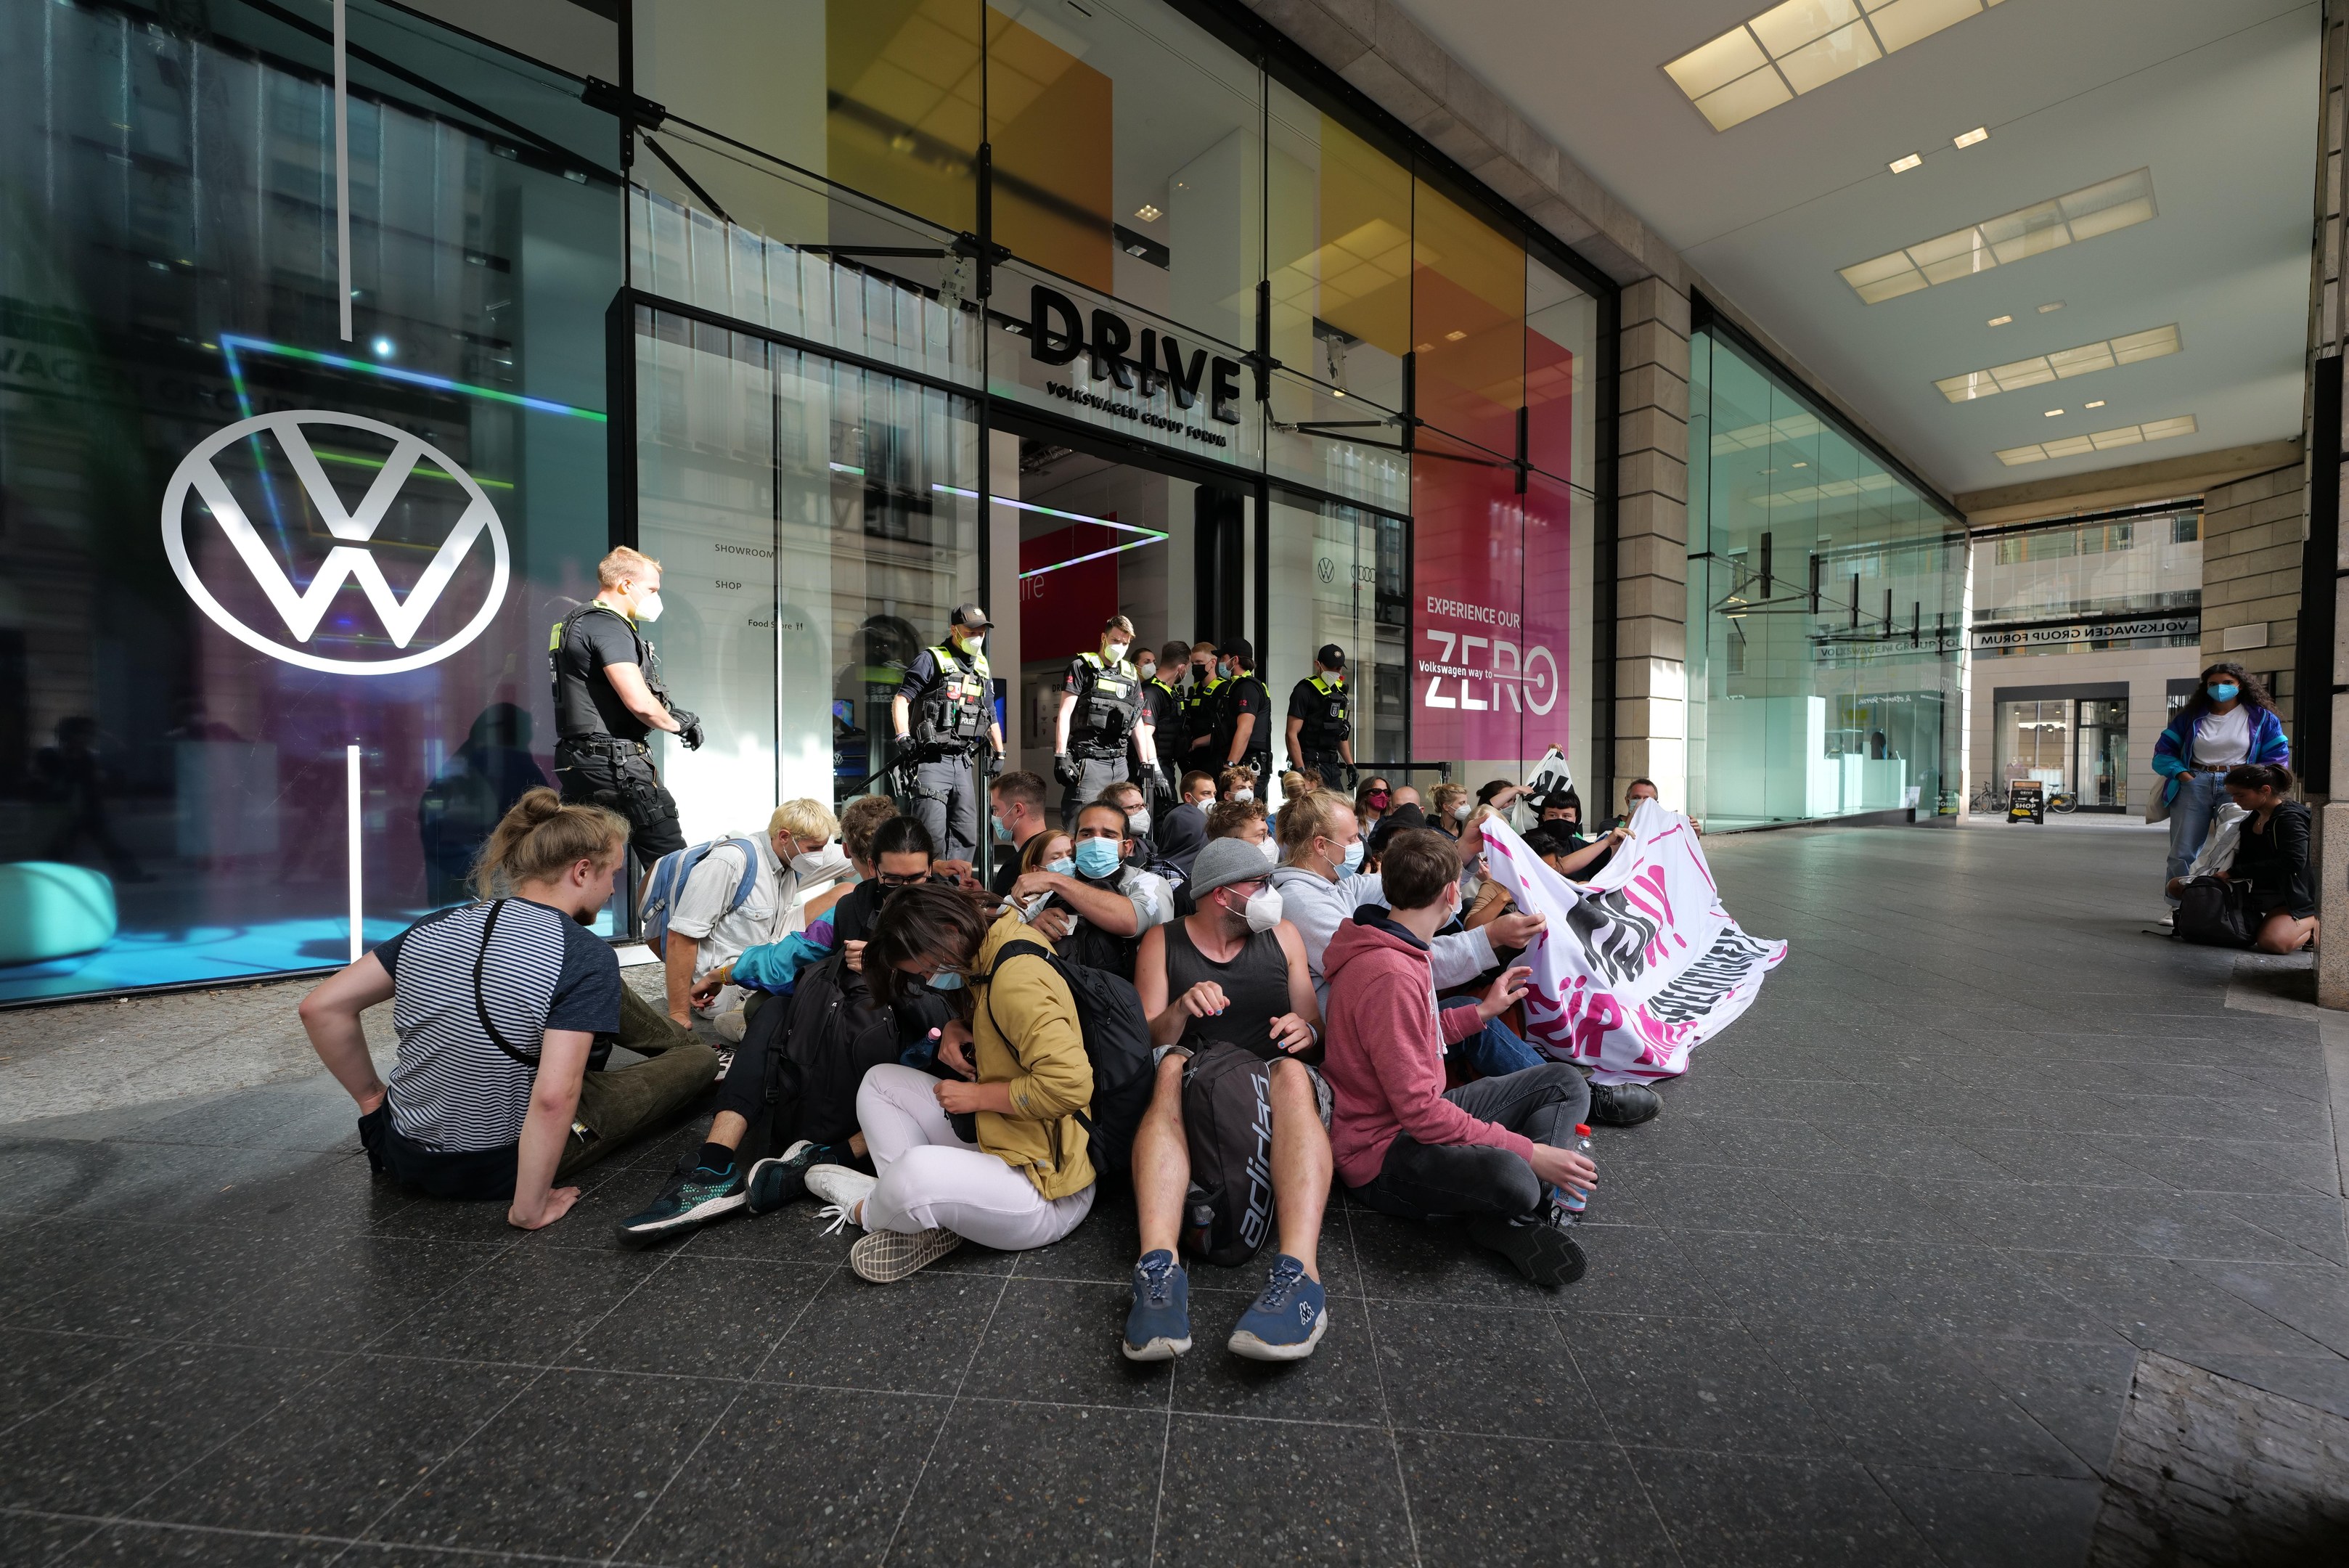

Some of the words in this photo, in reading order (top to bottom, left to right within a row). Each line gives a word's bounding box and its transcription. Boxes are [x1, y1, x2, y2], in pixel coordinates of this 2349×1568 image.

[1031, 285, 1241, 425] DRIVE
[1046, 381, 1139, 420] VOLKSWAGEN
[1141, 412, 1184, 433] GROUP
[1187, 425, 1227, 447] FORUM
[715, 544, 775, 558] SHOWROOM
[716, 580, 742, 590] SHOP
[1019, 568, 1045, 603] ife
[748, 619, 769, 628] Food
[1427, 596, 1496, 624] EXPERIENCE
[1498, 611, 1521, 629] OUR
[1419, 660, 1466, 677] Volkswagen
[1468, 669, 1483, 681] way
[1484, 669, 1492, 679] to
[1425, 629, 1558, 716] ZERO
[1143, 709, 1152, 717] 22
